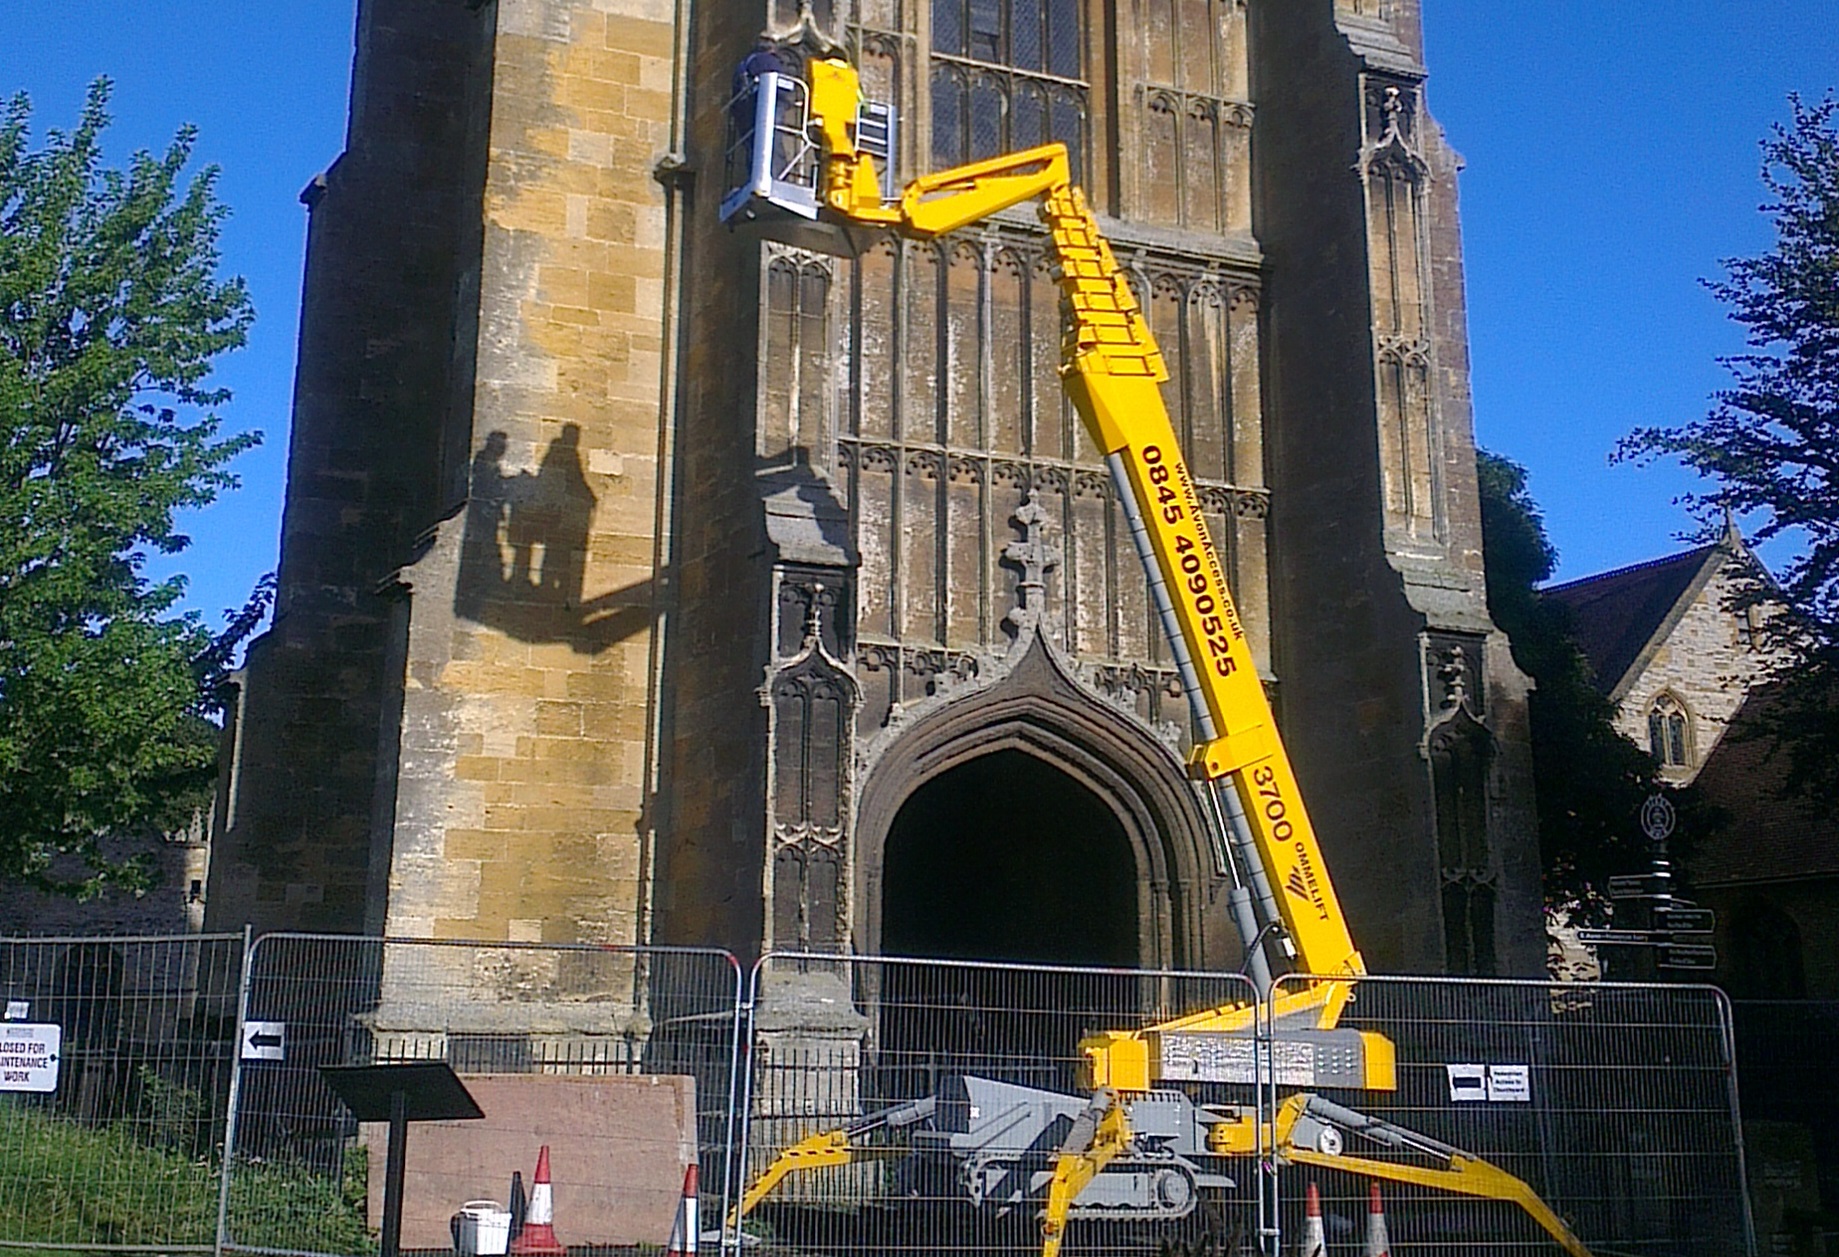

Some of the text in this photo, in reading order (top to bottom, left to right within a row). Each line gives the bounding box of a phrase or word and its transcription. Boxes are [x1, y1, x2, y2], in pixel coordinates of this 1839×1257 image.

[1142, 445, 1237, 677] 0845 4090525
[1174, 461, 1243, 641] www.AvonAccess.co.uk
[1253, 765, 1293, 842] 3700
[1295, 842, 1330, 921] OMMELIFT
[0, 1042, 45, 1054] LOSED FOR
[0, 1056, 48, 1069] INTENANCE
[4, 1071, 29, 1082] WORK
